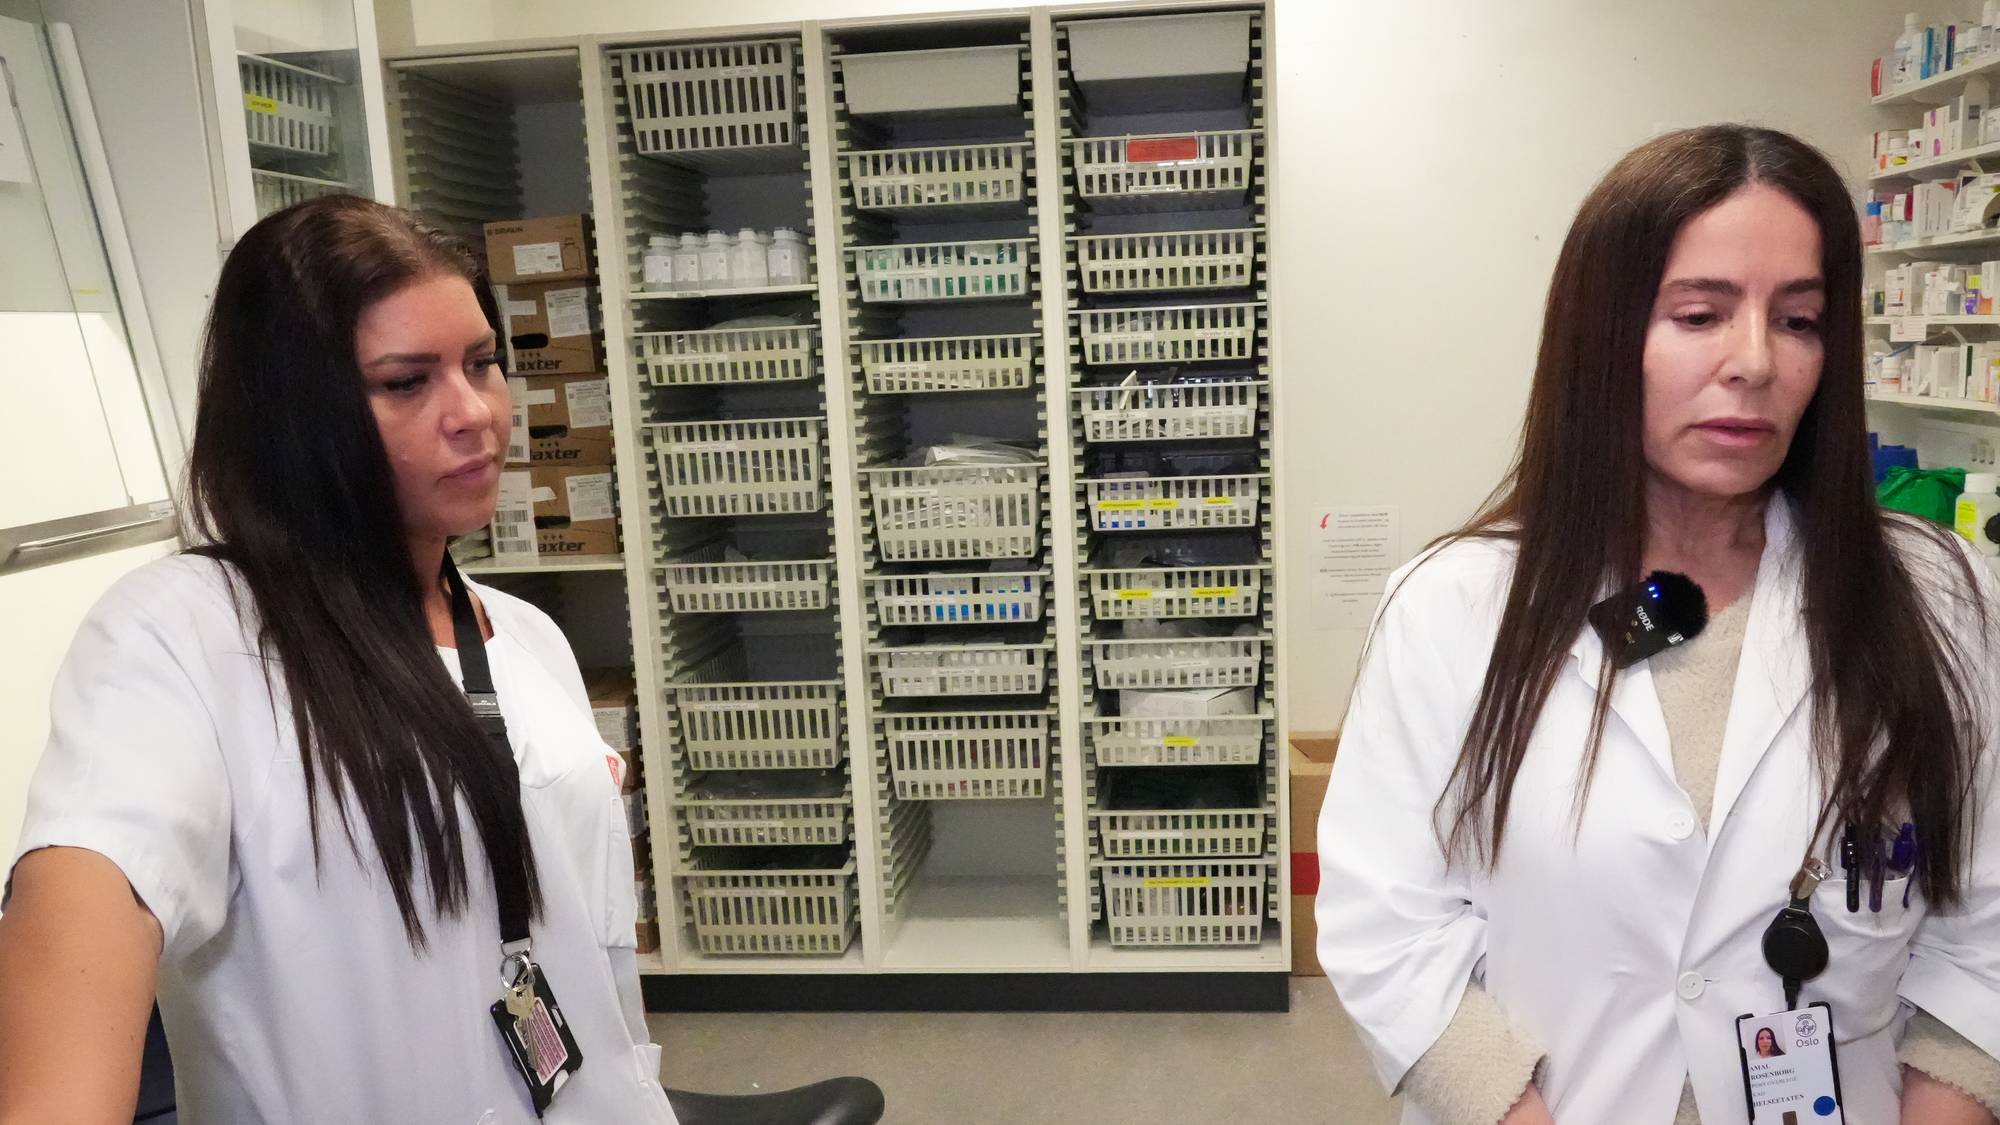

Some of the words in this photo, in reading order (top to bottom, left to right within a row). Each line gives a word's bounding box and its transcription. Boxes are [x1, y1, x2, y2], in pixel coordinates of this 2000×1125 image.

[516, 358, 563, 371] axter
[537, 541, 587, 553] axter
[1796, 1037, 1819, 1048] Oslo
[1751, 1068, 1796, 1081] ROSENBORG
